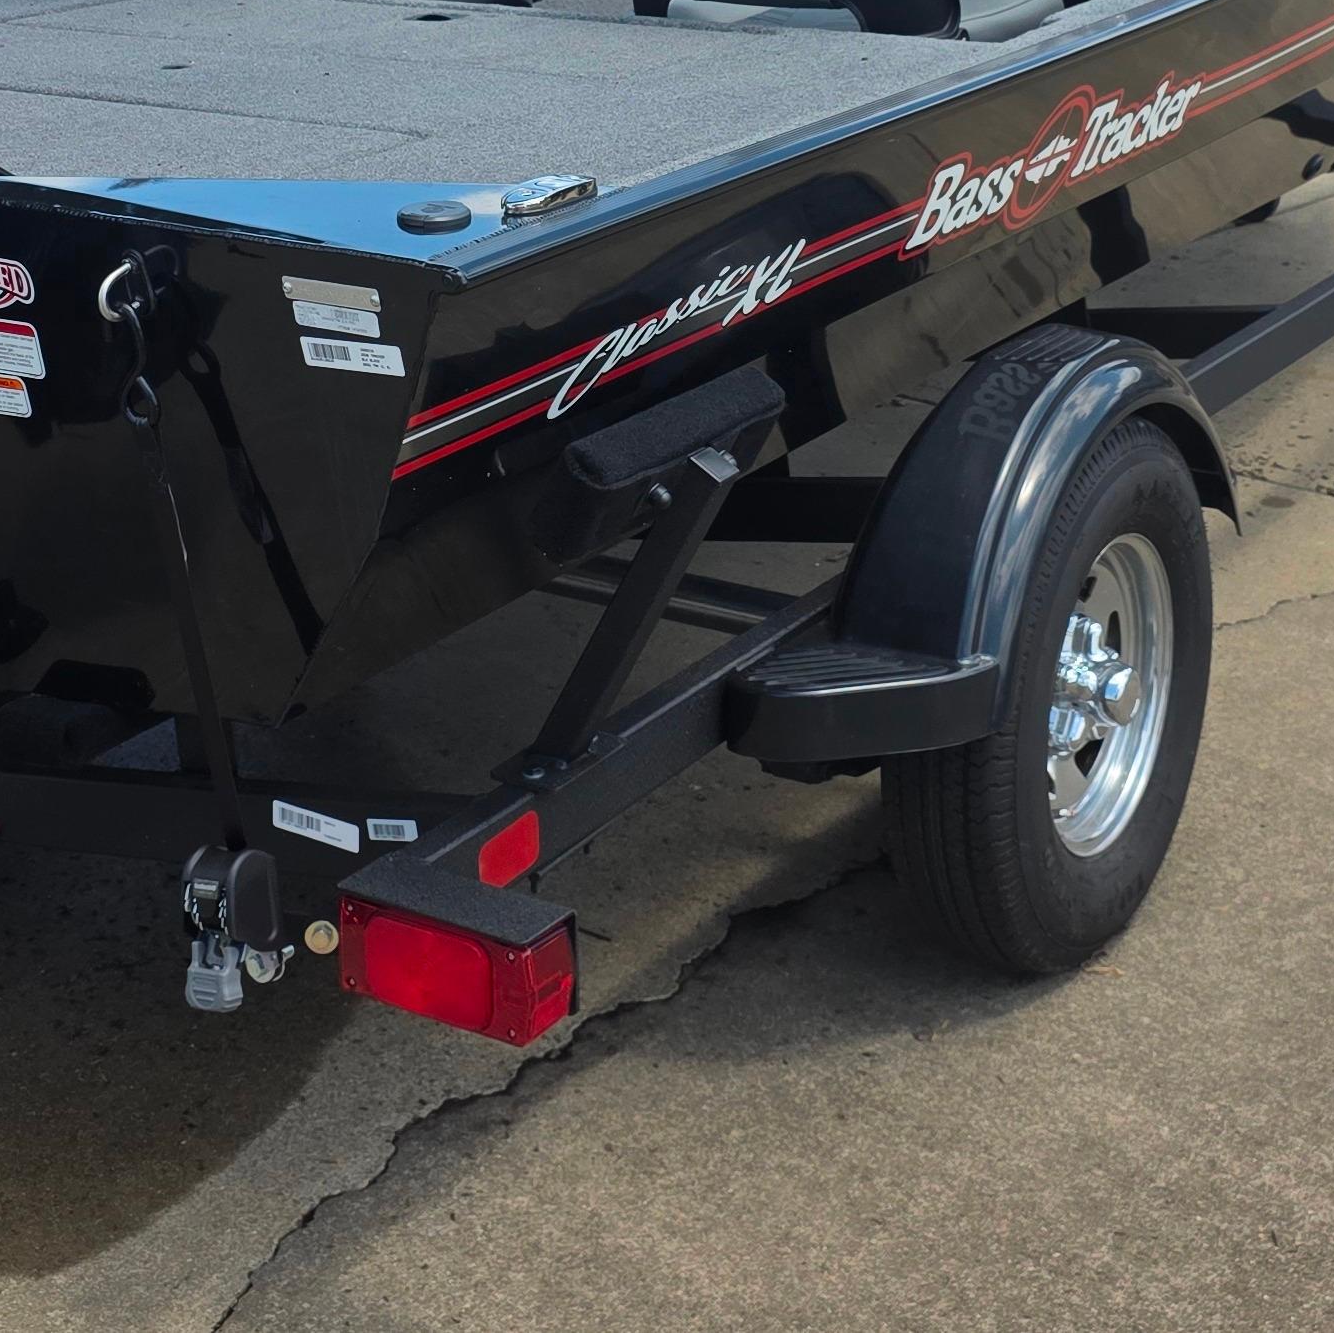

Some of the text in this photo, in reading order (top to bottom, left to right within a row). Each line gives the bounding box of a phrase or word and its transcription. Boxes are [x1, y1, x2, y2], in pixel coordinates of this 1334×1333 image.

[905, 80, 1201, 250] Bass Tracker
[546, 265, 755, 420] Classic
